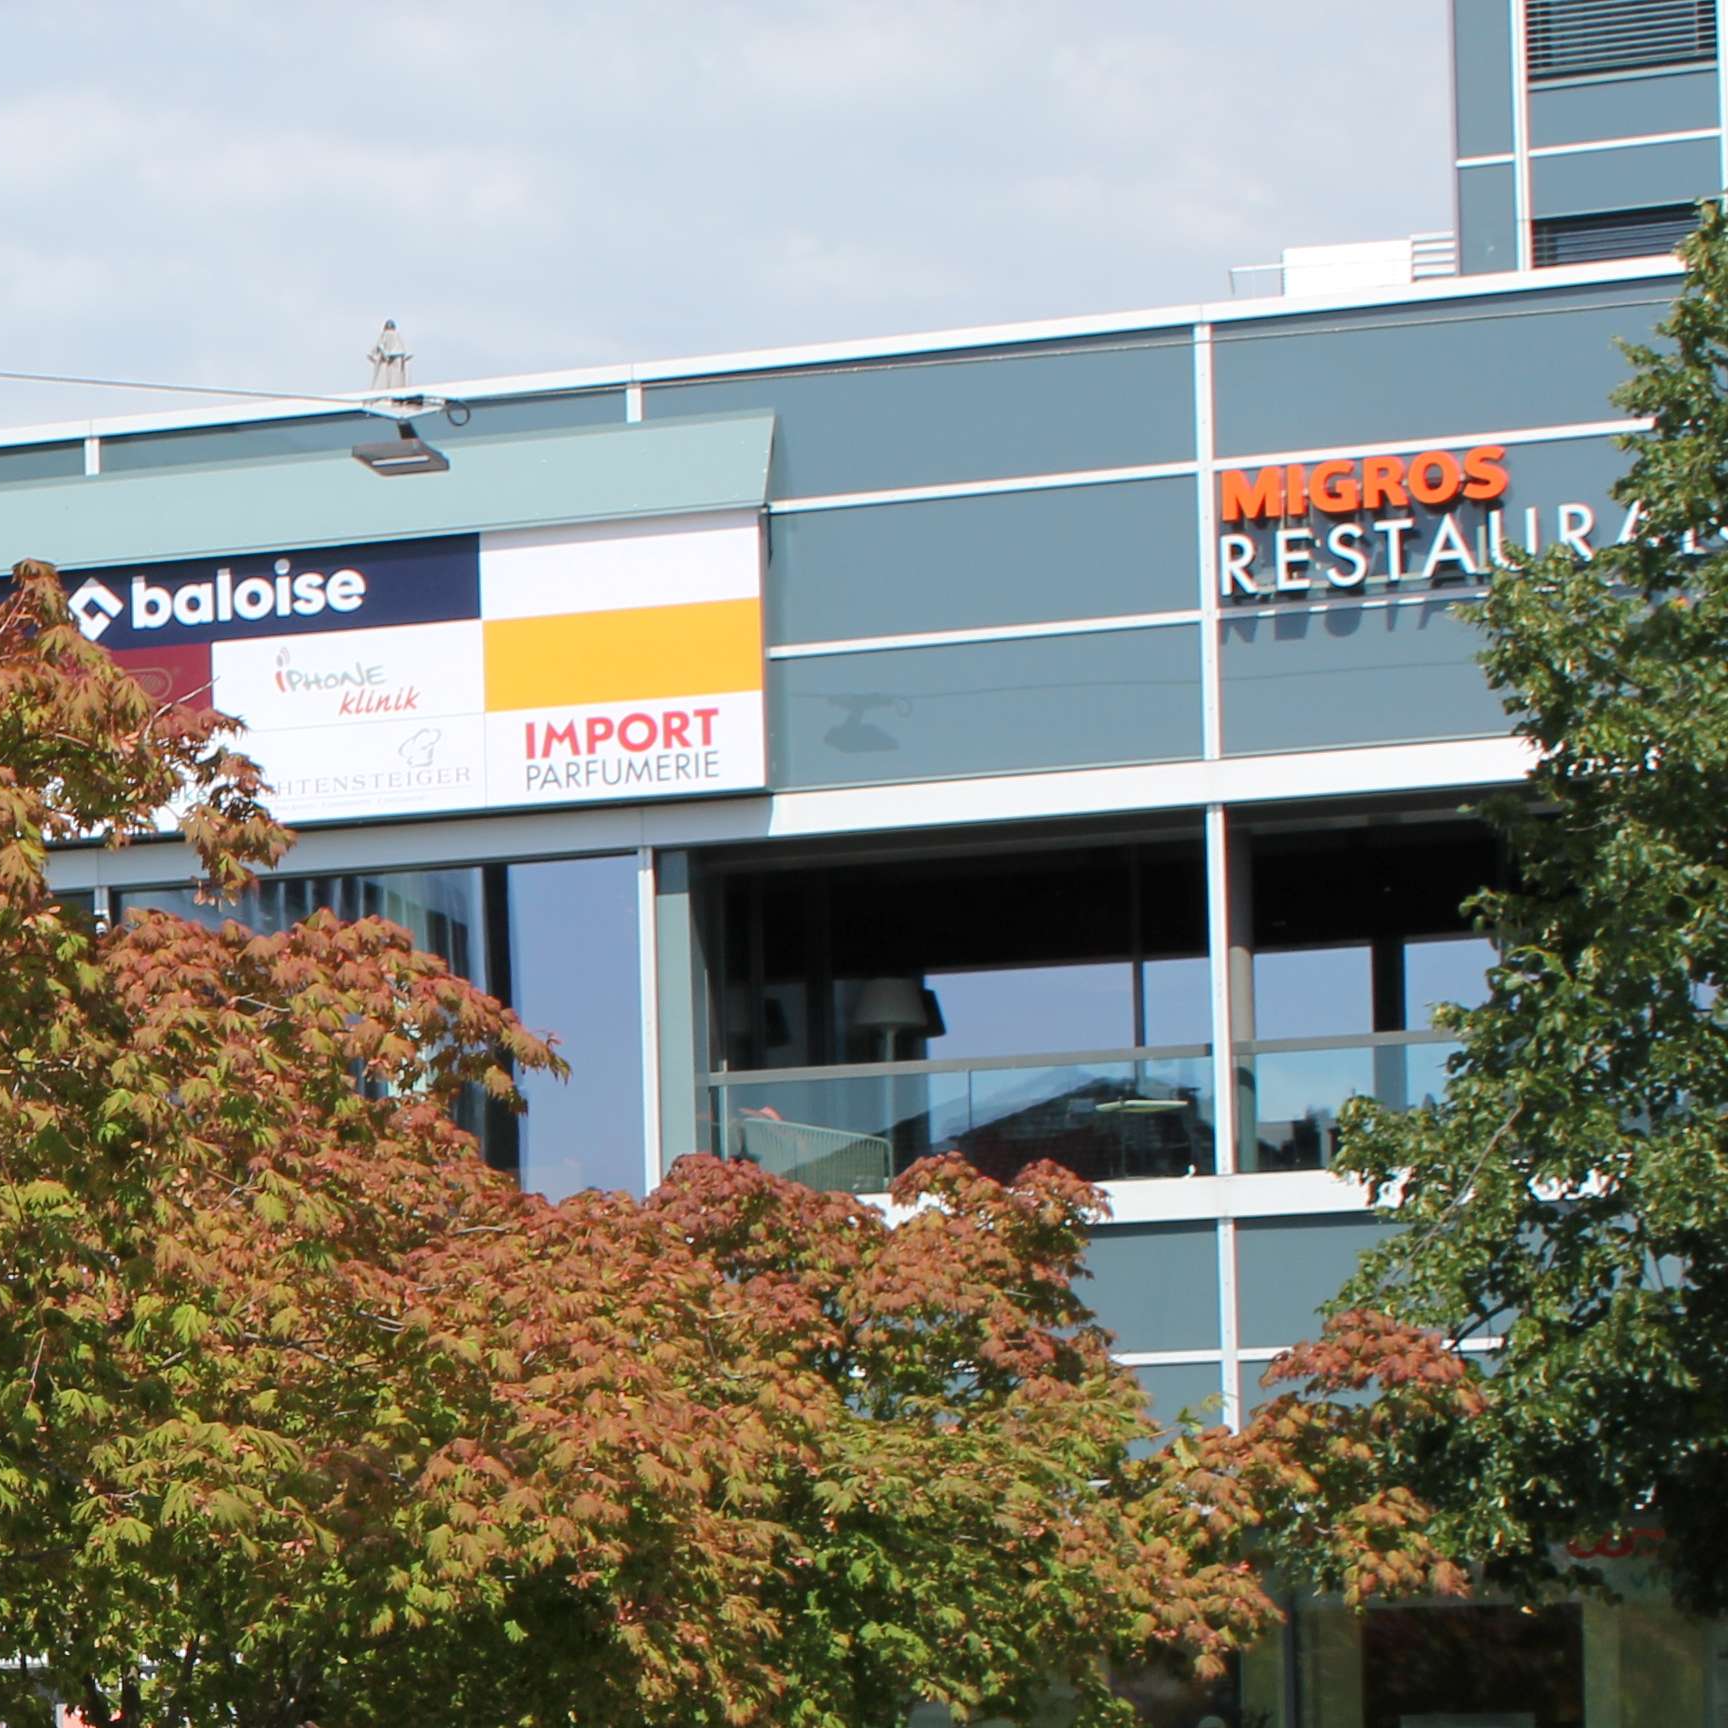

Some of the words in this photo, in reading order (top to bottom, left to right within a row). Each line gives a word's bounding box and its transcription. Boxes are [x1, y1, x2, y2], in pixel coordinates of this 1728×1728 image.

[1220, 445, 1510, 522] MIGROS
[1220, 500, 1728, 597] RESTAURA
[131, 558, 366, 629] baloise
[339, 686, 421, 716] klinik
[525, 708, 719, 760] IMPORT
[277, 766, 472, 796] HTENSTEIGER
[526, 751, 720, 792] PARFUMERIE
